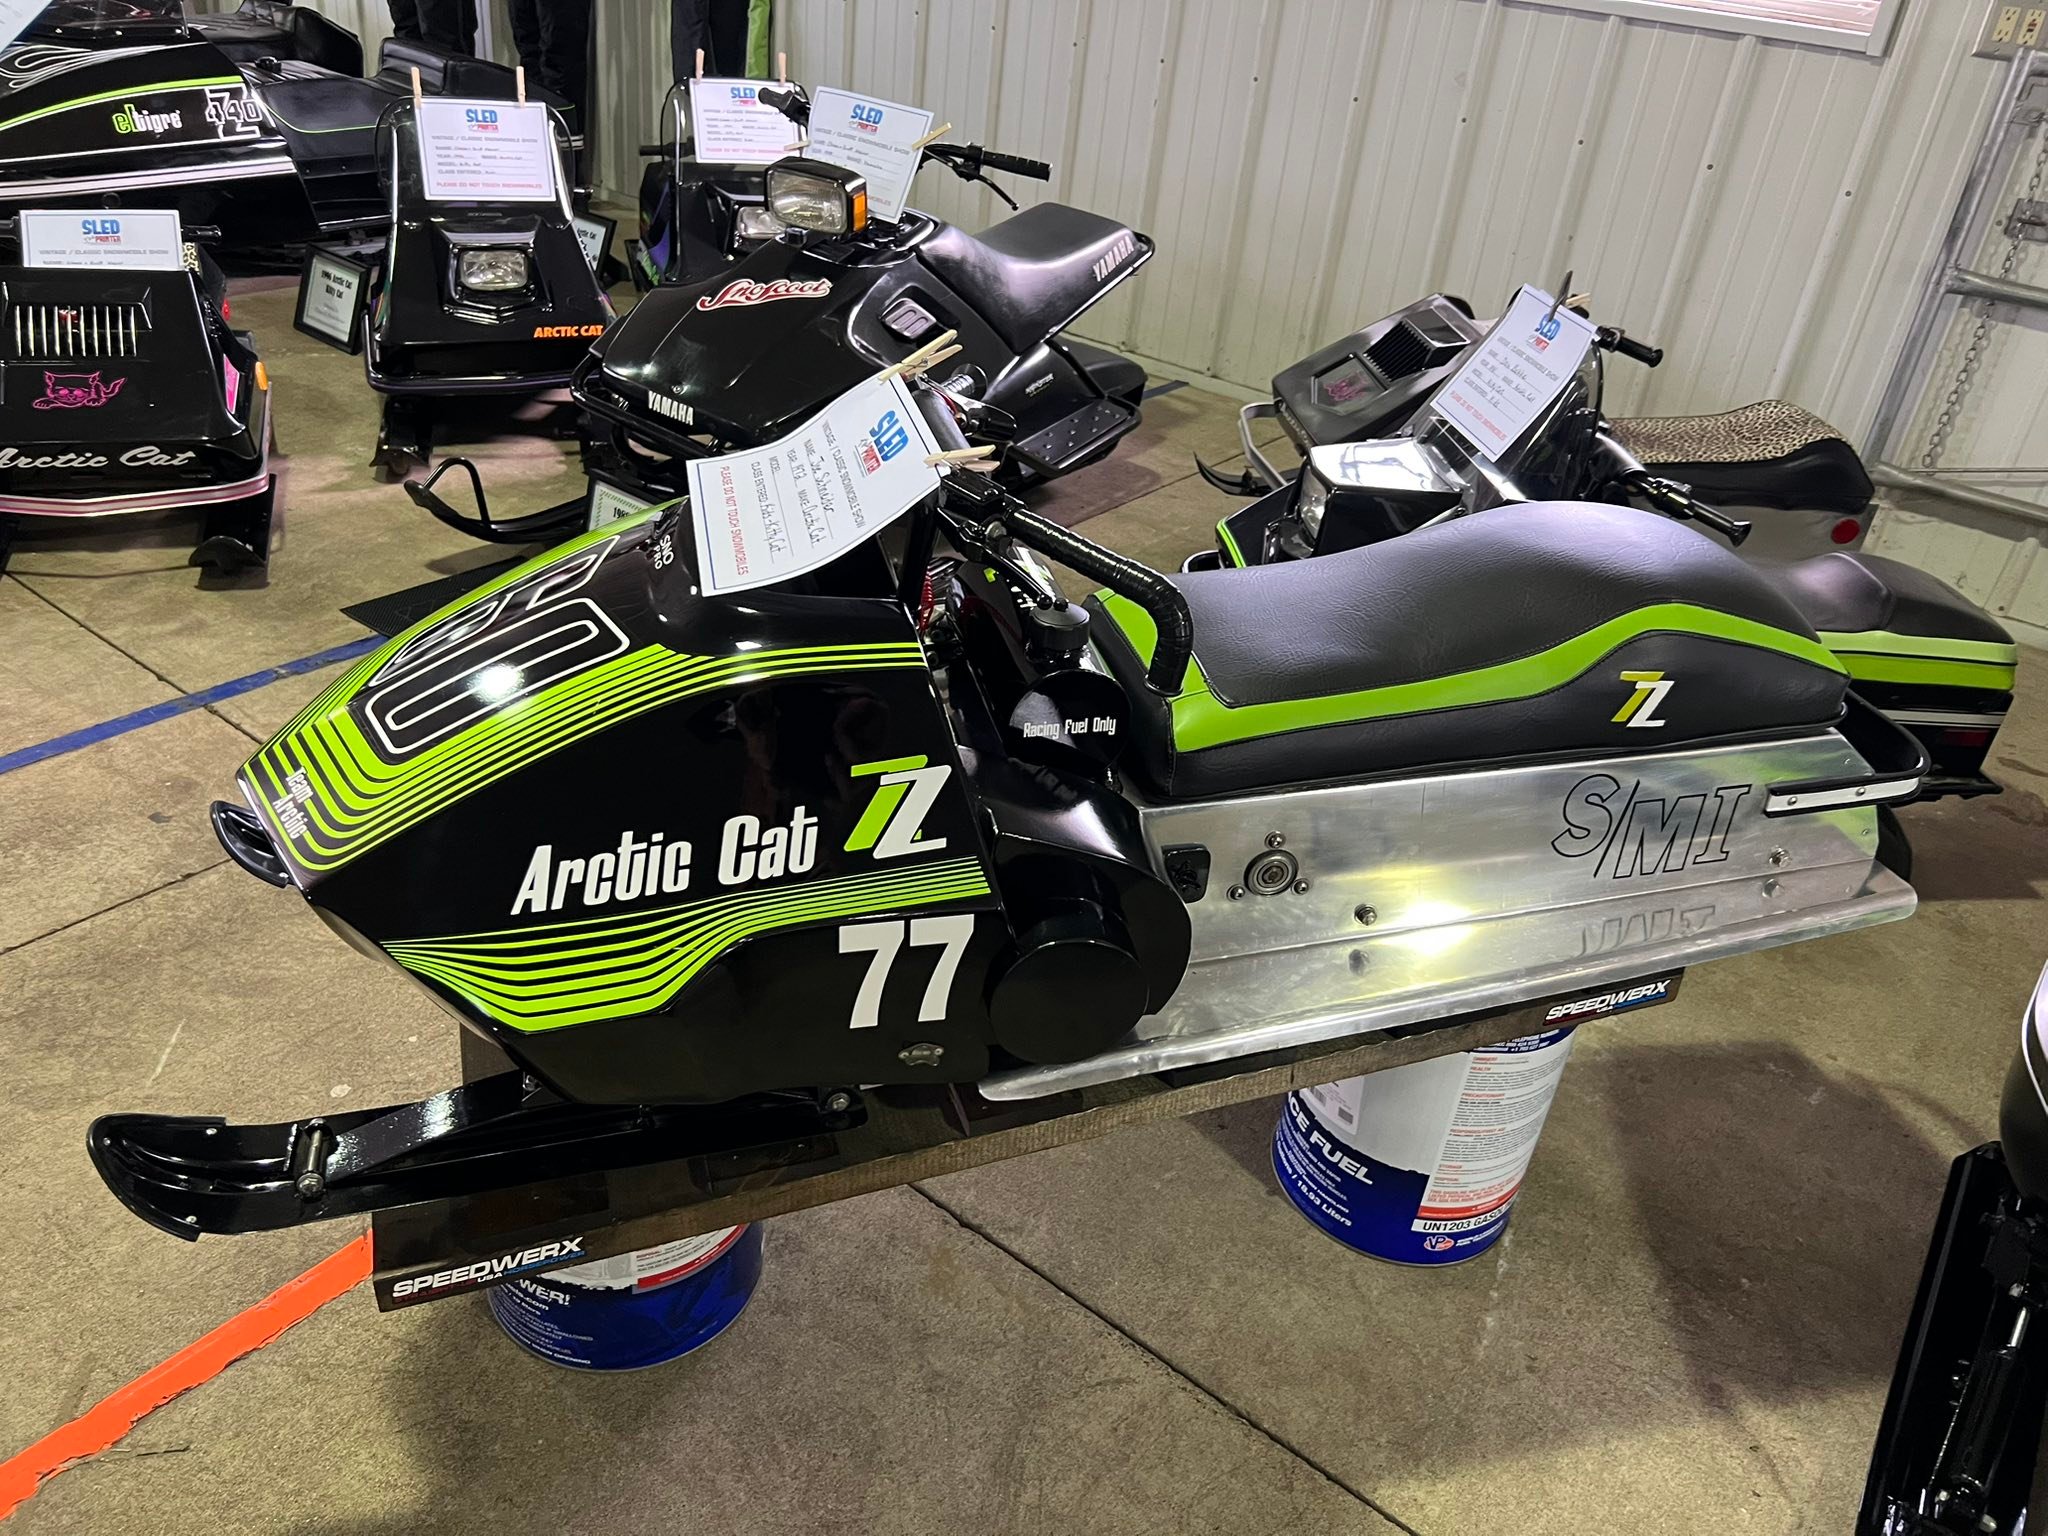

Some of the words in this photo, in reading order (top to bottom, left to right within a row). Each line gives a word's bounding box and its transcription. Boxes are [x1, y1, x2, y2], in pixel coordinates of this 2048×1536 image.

[730, 87, 756, 99] SLED
[205, 99, 262, 125] 440
[465, 109, 498, 124] SLED
[851, 104, 884, 125] SLED
[82, 219, 121, 236] SLED
[1092, 235, 1135, 282] YAMAHA
[533, 325, 580, 339] ARCTIC
[580, 324, 604, 337] CAT
[648, 390, 694, 426] YAMAHA
[869, 410, 909, 462] SLED
[0, 447, 109, 469] Arctic
[119, 446, 196, 467] Cat
[751, 461, 764, 479] CLASS
[861, 445, 882, 475] PRINTER
[720, 465, 734, 487] PLEASE
[723, 486, 735, 496] DO
[726, 495, 738, 508] NOT
[728, 508, 740, 529] TOUCH
[653, 544, 663, 570] PRO
[660, 534, 675, 565] SNO
[731, 528, 749, 576] SNOWMOBILES
[1023, 721, 1060, 740] Racing
[1064, 718, 1088, 735] Fuel
[1092, 716, 1117, 736] Only
[285, 766, 314, 804] Team
[272, 793, 308, 840] Arctic
[510, 830, 693, 916] Arctic
[718, 805, 819, 886] Cat
[838, 914, 975, 1029] 77
[1545, 979, 1671, 1021] SPEEDWERX
[1309, 1130, 1373, 1185] FUEL
[1321, 1203, 1353, 1227] Liters
[1423, 1220, 1471, 1231] UN1203
[392, 1236, 584, 1298] SPEEDWERX
[477, 1272, 503, 1284] USA
[503, 1250, 586, 1276] HORSEPOWER
